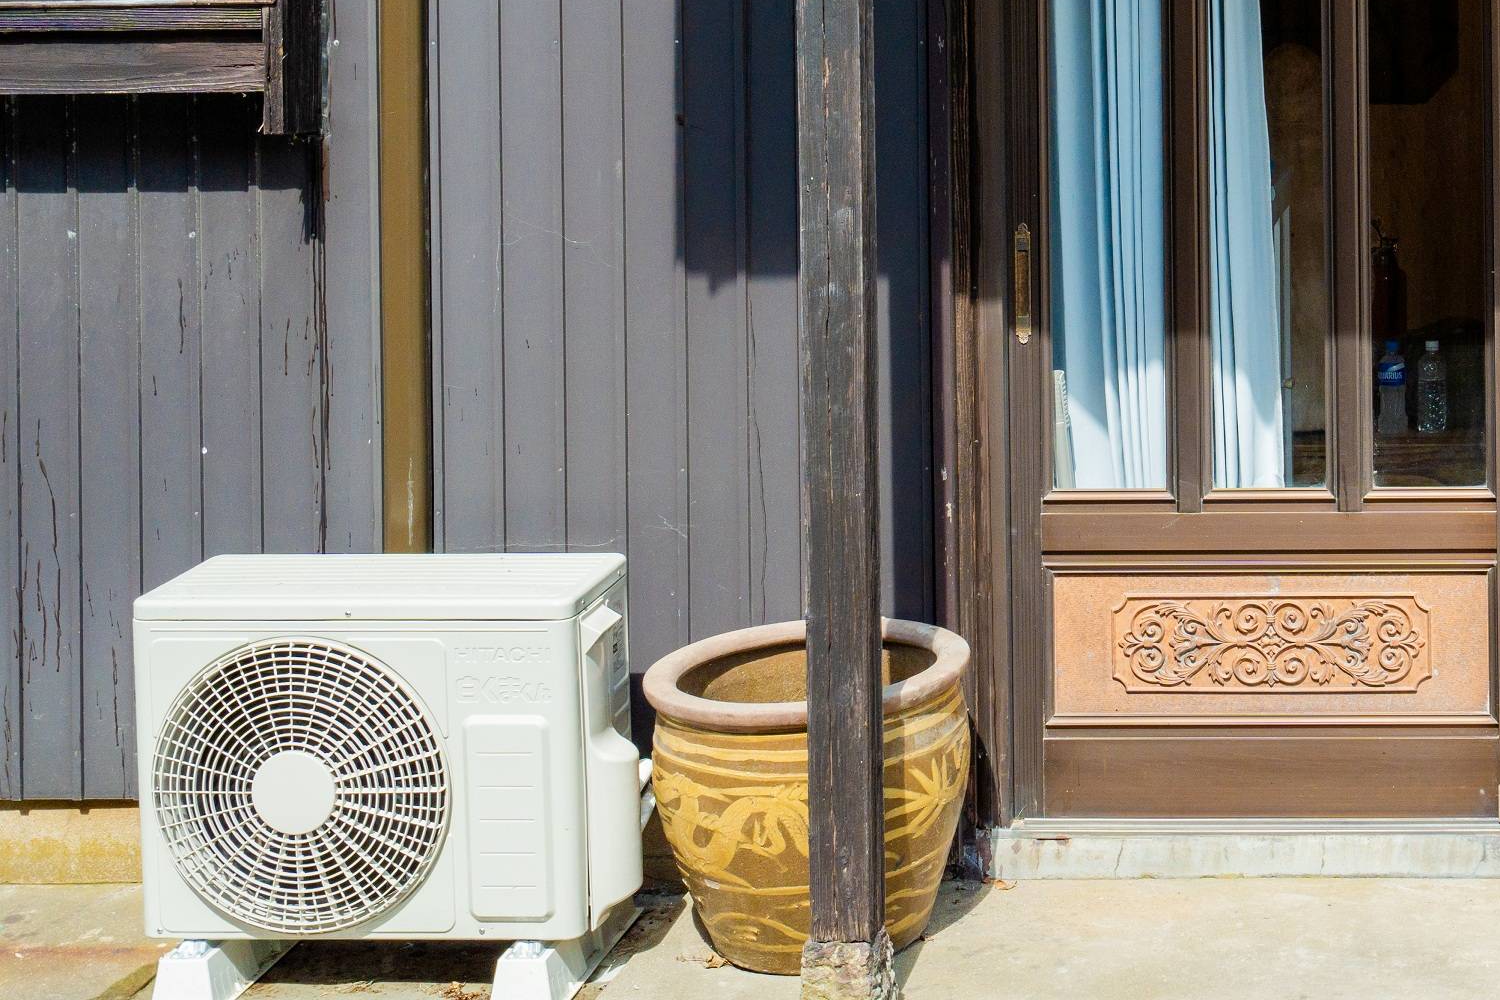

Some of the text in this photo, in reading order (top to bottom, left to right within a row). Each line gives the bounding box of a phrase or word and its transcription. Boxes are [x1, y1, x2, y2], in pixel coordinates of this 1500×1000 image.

[454, 647, 552, 663] HITACHI
[455, 675, 553, 703] 白くまくん
